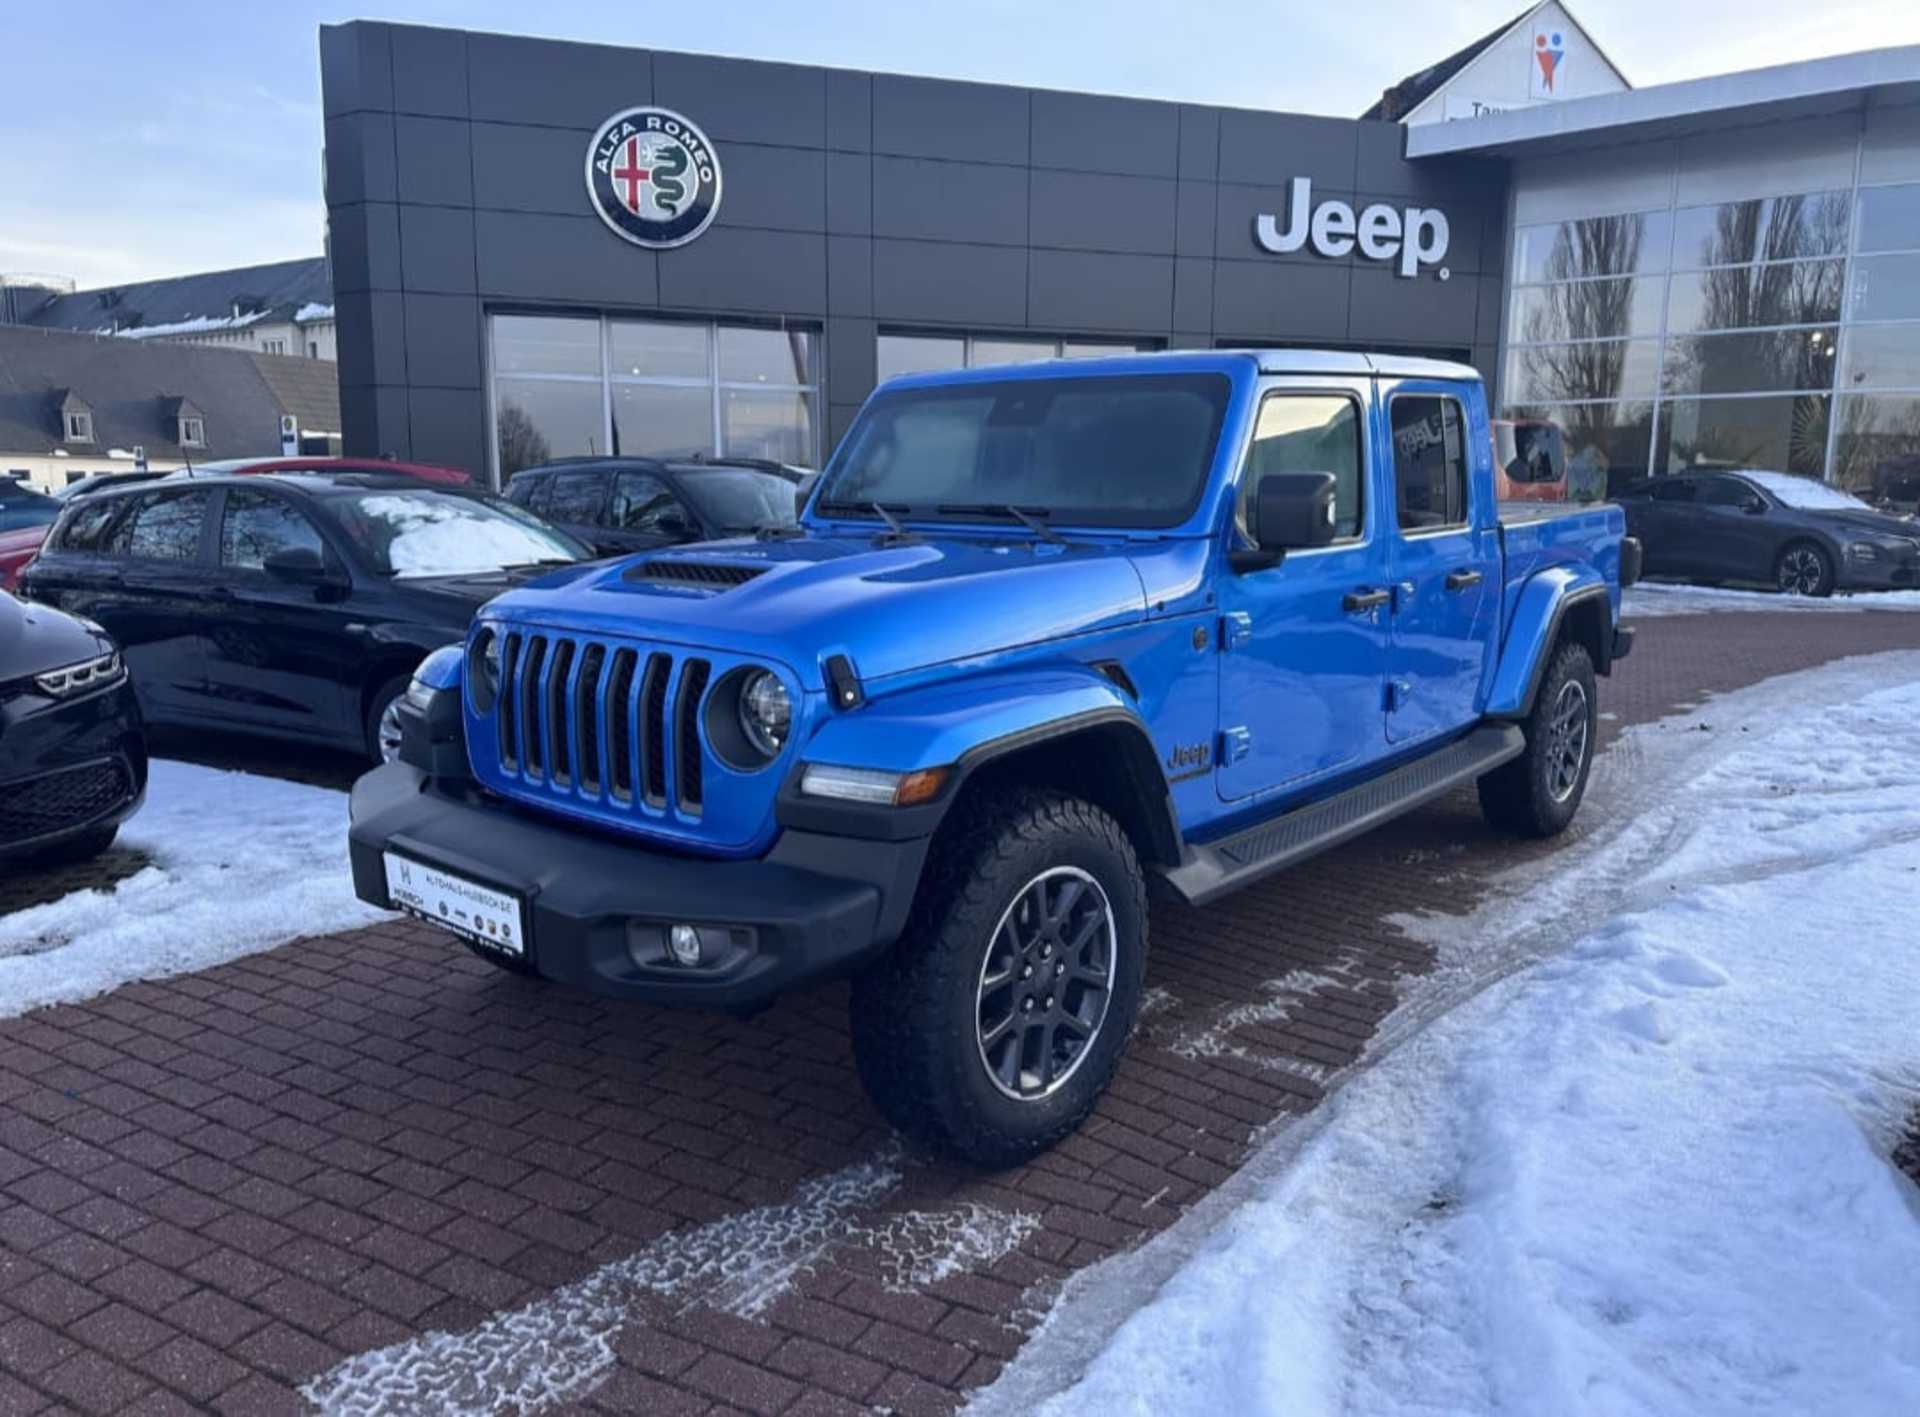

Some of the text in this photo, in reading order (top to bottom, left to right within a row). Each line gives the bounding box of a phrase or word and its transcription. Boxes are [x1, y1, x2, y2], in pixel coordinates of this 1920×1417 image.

[596, 116, 713, 183] ALFA ROMEO
[1257, 176, 1450, 278] Jeep
[1168, 741, 1208, 768] Jeep
